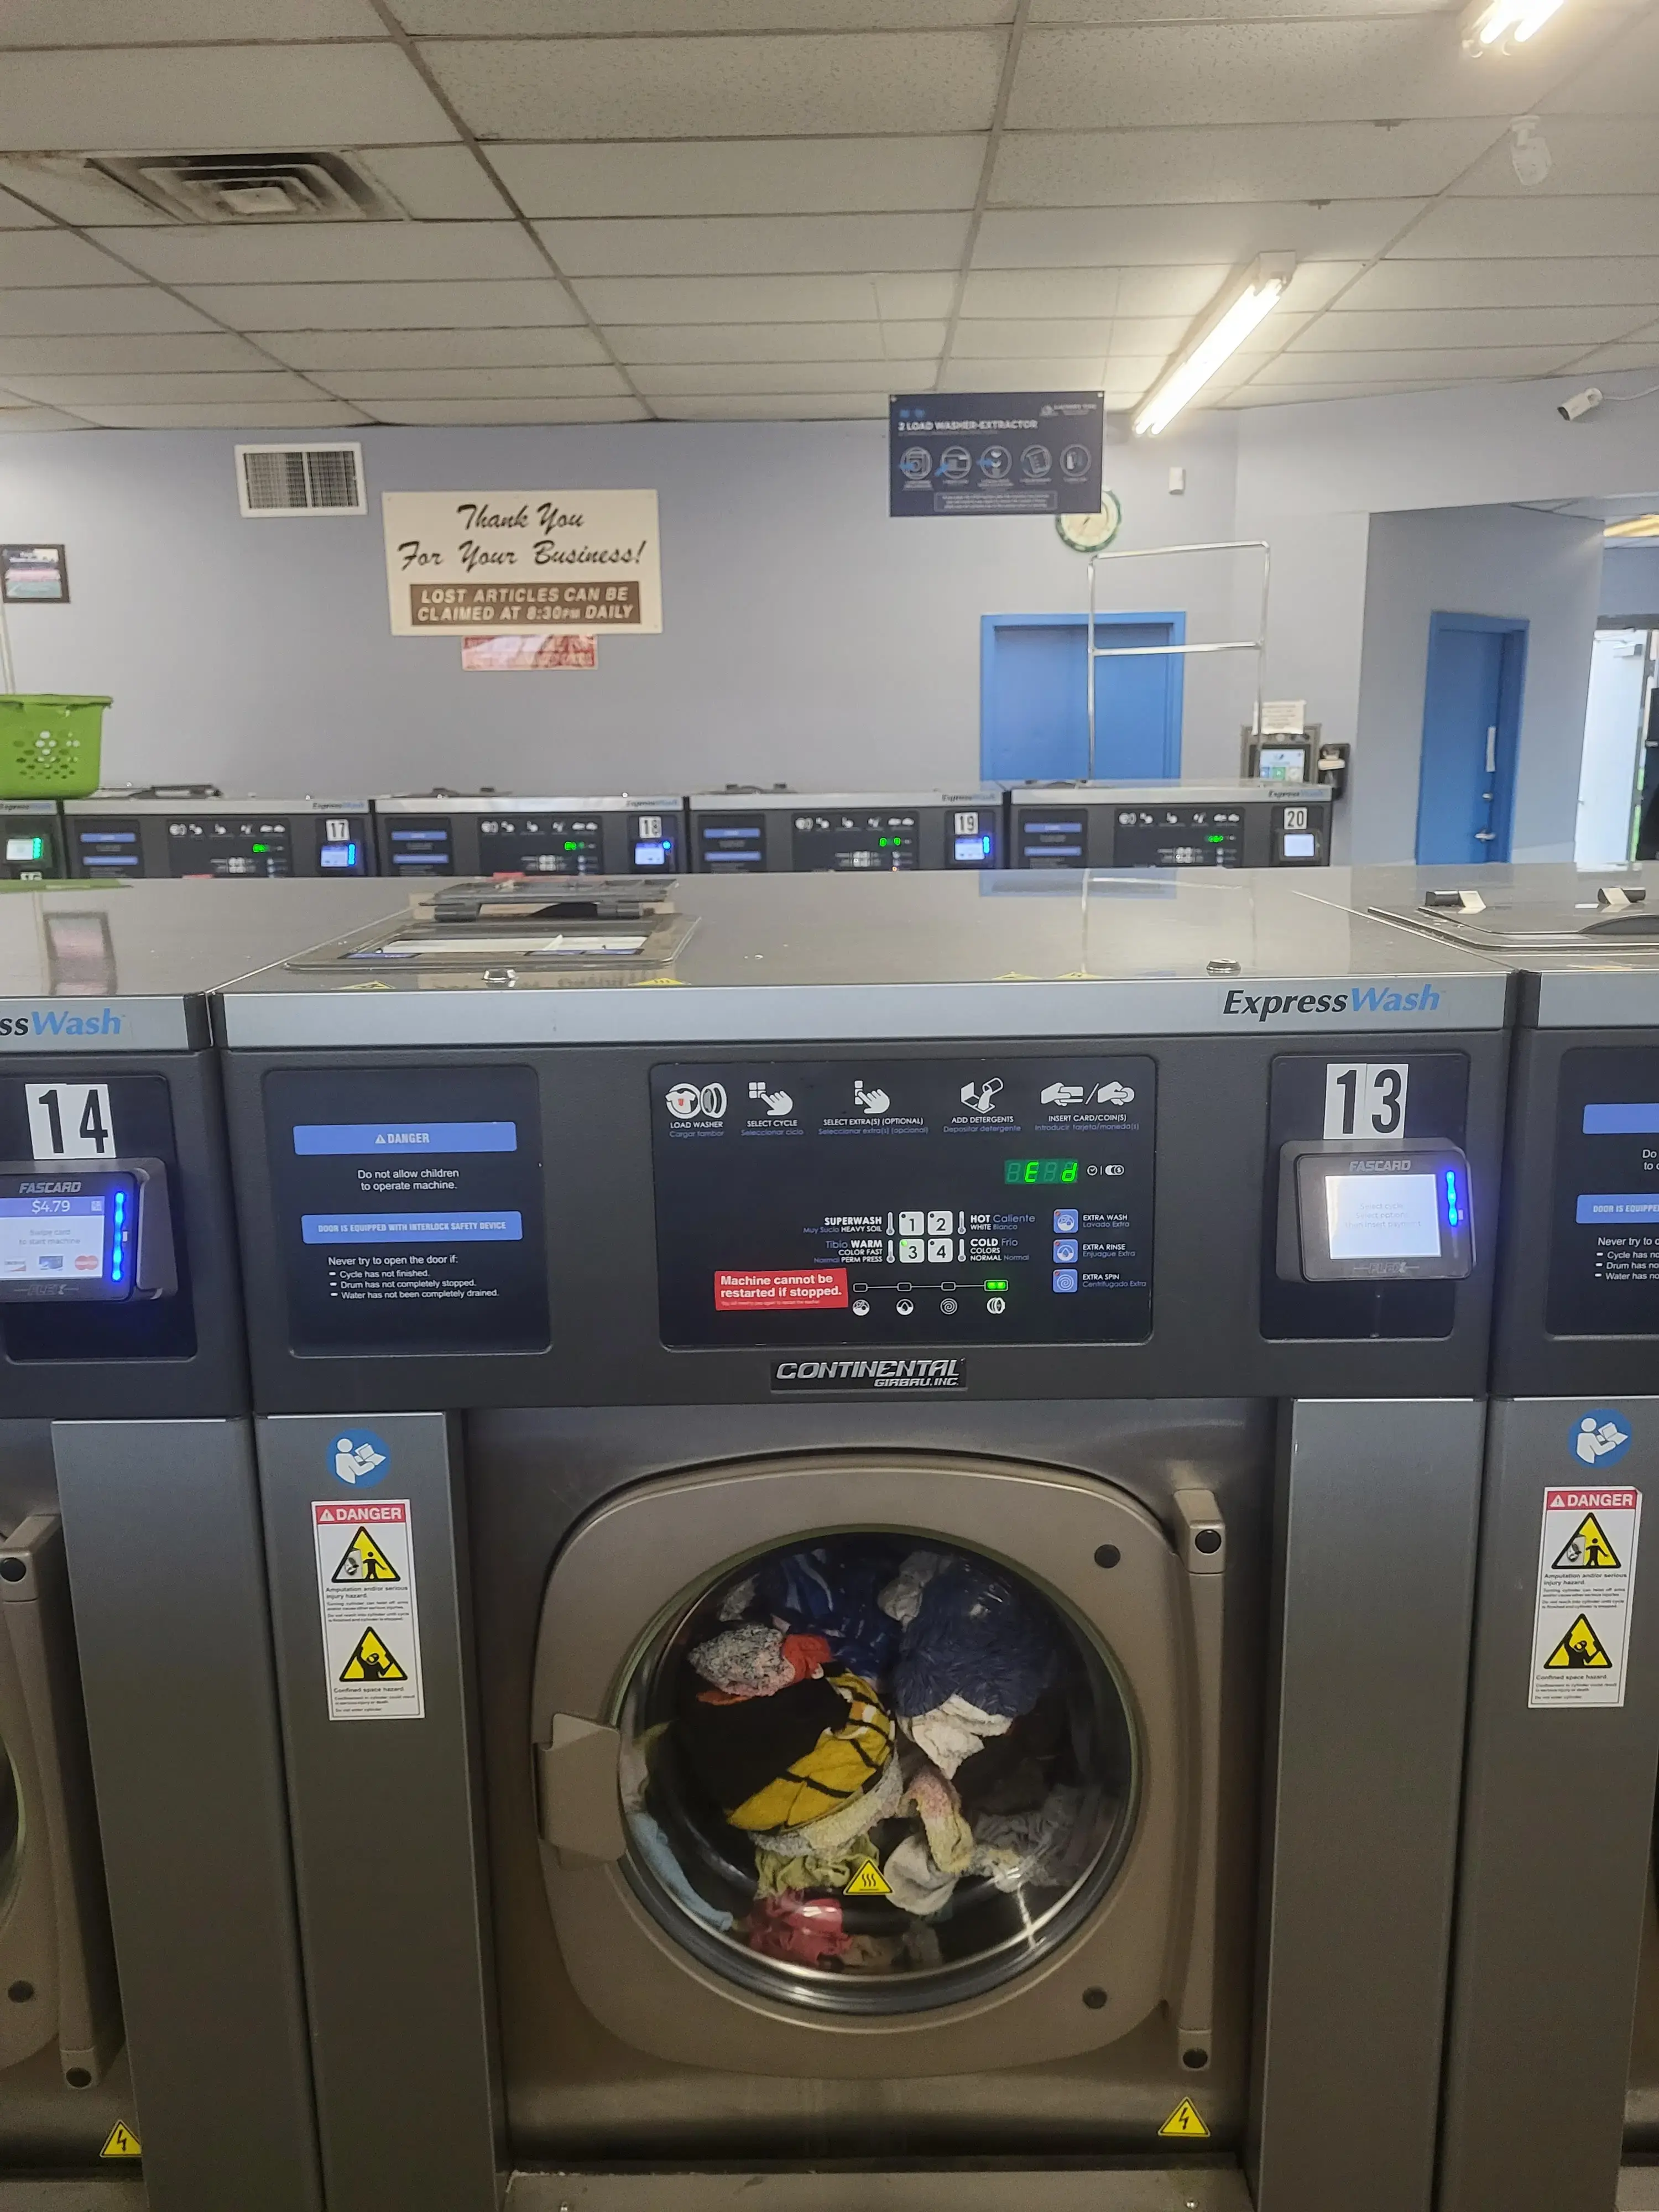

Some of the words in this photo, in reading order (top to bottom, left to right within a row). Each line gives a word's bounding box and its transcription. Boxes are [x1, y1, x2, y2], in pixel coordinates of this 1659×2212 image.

[898, 422, 905, 431] 2
[906, 421, 933, 430] LOAD
[457, 504, 529, 530] Thank
[537, 503, 585, 534] You
[398, 541, 444, 570] For
[459, 540, 518, 573] Your
[533, 540, 648, 565] Business!
[421, 588, 467, 604] LOST
[473, 587, 559, 603] ARTICLES
[564, 587, 600, 602] CAN
[606, 586, 628, 602] BE
[418, 606, 494, 621] CLAIMED
[499, 606, 521, 620] AT
[585, 604, 633, 619] DAILY
[960, 816, 975, 832] 19
[1287, 811, 1304, 827] 20
[331, 822, 345, 837] 17
[1223, 984, 1441, 1022] ExpressWash
[1336, 1069, 1402, 1134] 13
[39, 1089, 108, 1154] 14
[882, 1117, 924, 1125] (OPTIONAL)
[1073, 1114, 1127, 1123] CARD/COIN(S)
[388, 1133, 430, 1145] DANGER
[1642, 1150, 1657, 1159] Do
[1349, 1160, 1411, 1172] FASCARD
[358, 1169, 372, 1180] Do
[375, 1170, 390, 1180] not
[393, 1168, 419, 1179] allow
[421, 1168, 460, 1179] children
[19, 1182, 81, 1194] FASCARD
[361, 1182, 371, 1191] to
[373, 1182, 410, 1192] operate
[413, 1180, 457, 1190] machine.
[32, 1199, 70, 1214] $4.79
[1593, 1205, 1614, 1213] DOOR
[825, 1216, 882, 1226] SUPERWASH
[935, 1217, 946, 1232] 2
[971, 1214, 990, 1223] HOT
[993, 1214, 1035, 1223] Caliente
[318, 1224, 338, 1233] DOOR
[341, 1224, 348, 1233] IS
[350, 1223, 387, 1233] EQUIPPED
[388, 1223, 408, 1232] WITH
[409, 1222, 450, 1231] INTERLOCK
[451, 1222, 478, 1230] SAFETY
[479, 1222, 507, 1230] DEVICE
[909, 1218, 915, 1232] 1
[825, 1240, 847, 1249] Tibio
[851, 1240, 883, 1248] WARM
[970, 1238, 998, 1247] COLD
[1001, 1238, 1018, 1246] Frio
[1598, 1237, 1626, 1246] Never
[1629, 1237, 1641, 1248] try
[909, 1245, 917, 1259] 3
[936, 1245, 947, 1259] 4
[1607, 1251, 1630, 1260] Cycle
[328, 1256, 356, 1266] Never
[358, 1256, 371, 1267] try
[373, 1256, 382, 1265] to
[384, 1257, 407, 1267] open
[409, 1255, 424, 1265] the
[426, 1255, 447, 1264] door
[450, 1254, 458, 1264] if:
[340, 1270, 363, 1280] Cycle
[364, 1270, 380, 1278] has
[382, 1270, 395, 1278] not
[396, 1269, 430, 1277] finished.
[720, 1276, 771, 1286] Machine
[774, 1275, 815, 1285] cannot
[817, 1275, 833, 1284] be
[341, 1281, 363, 1289] Drum
[397, 1280, 440, 1289] completely
[442, 1279, 476, 1288] stopped.
[399, 1290, 420, 1298] been
[421, 1290, 465, 1300] completely
[466, 1288, 499, 1297] drained.
[720, 1288, 774, 1298] restarted
[778, 1287, 787, 1297] if
[790, 1286, 842, 1299] stopped.
[776, 1359, 960, 1379] CONTINENTAL
[1567, 1494, 1633, 1507] DANGER
[336, 1507, 402, 1521] DANGER
